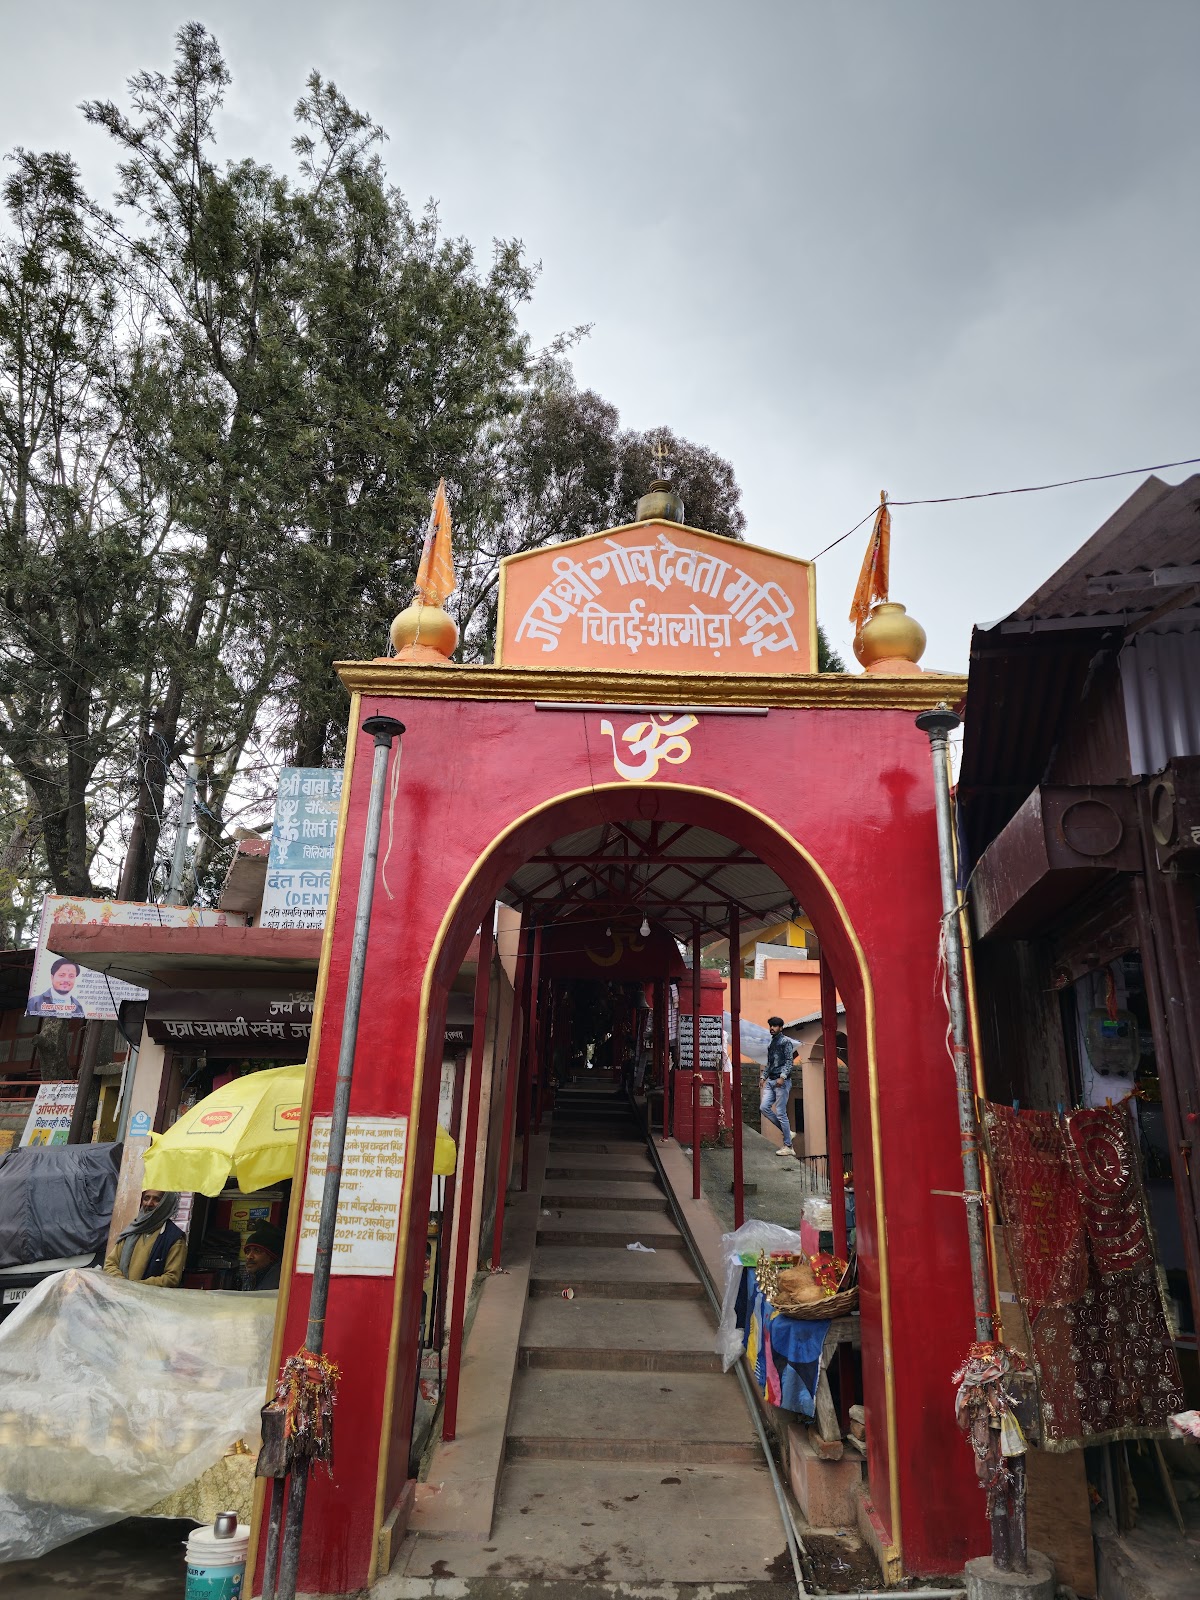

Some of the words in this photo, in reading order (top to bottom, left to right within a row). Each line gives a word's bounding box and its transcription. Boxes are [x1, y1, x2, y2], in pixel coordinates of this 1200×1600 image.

[514, 583, 578, 652] जय
[552, 556, 602, 605] श्री
[587, 538, 666, 592] गोलू
[656, 533, 732, 599] देवता
[281, 772, 302, 796] श्री
[302, 778, 330, 796] बाबा
[267, 870, 295, 890] दंत
[269, 1001, 294, 1016] जय
